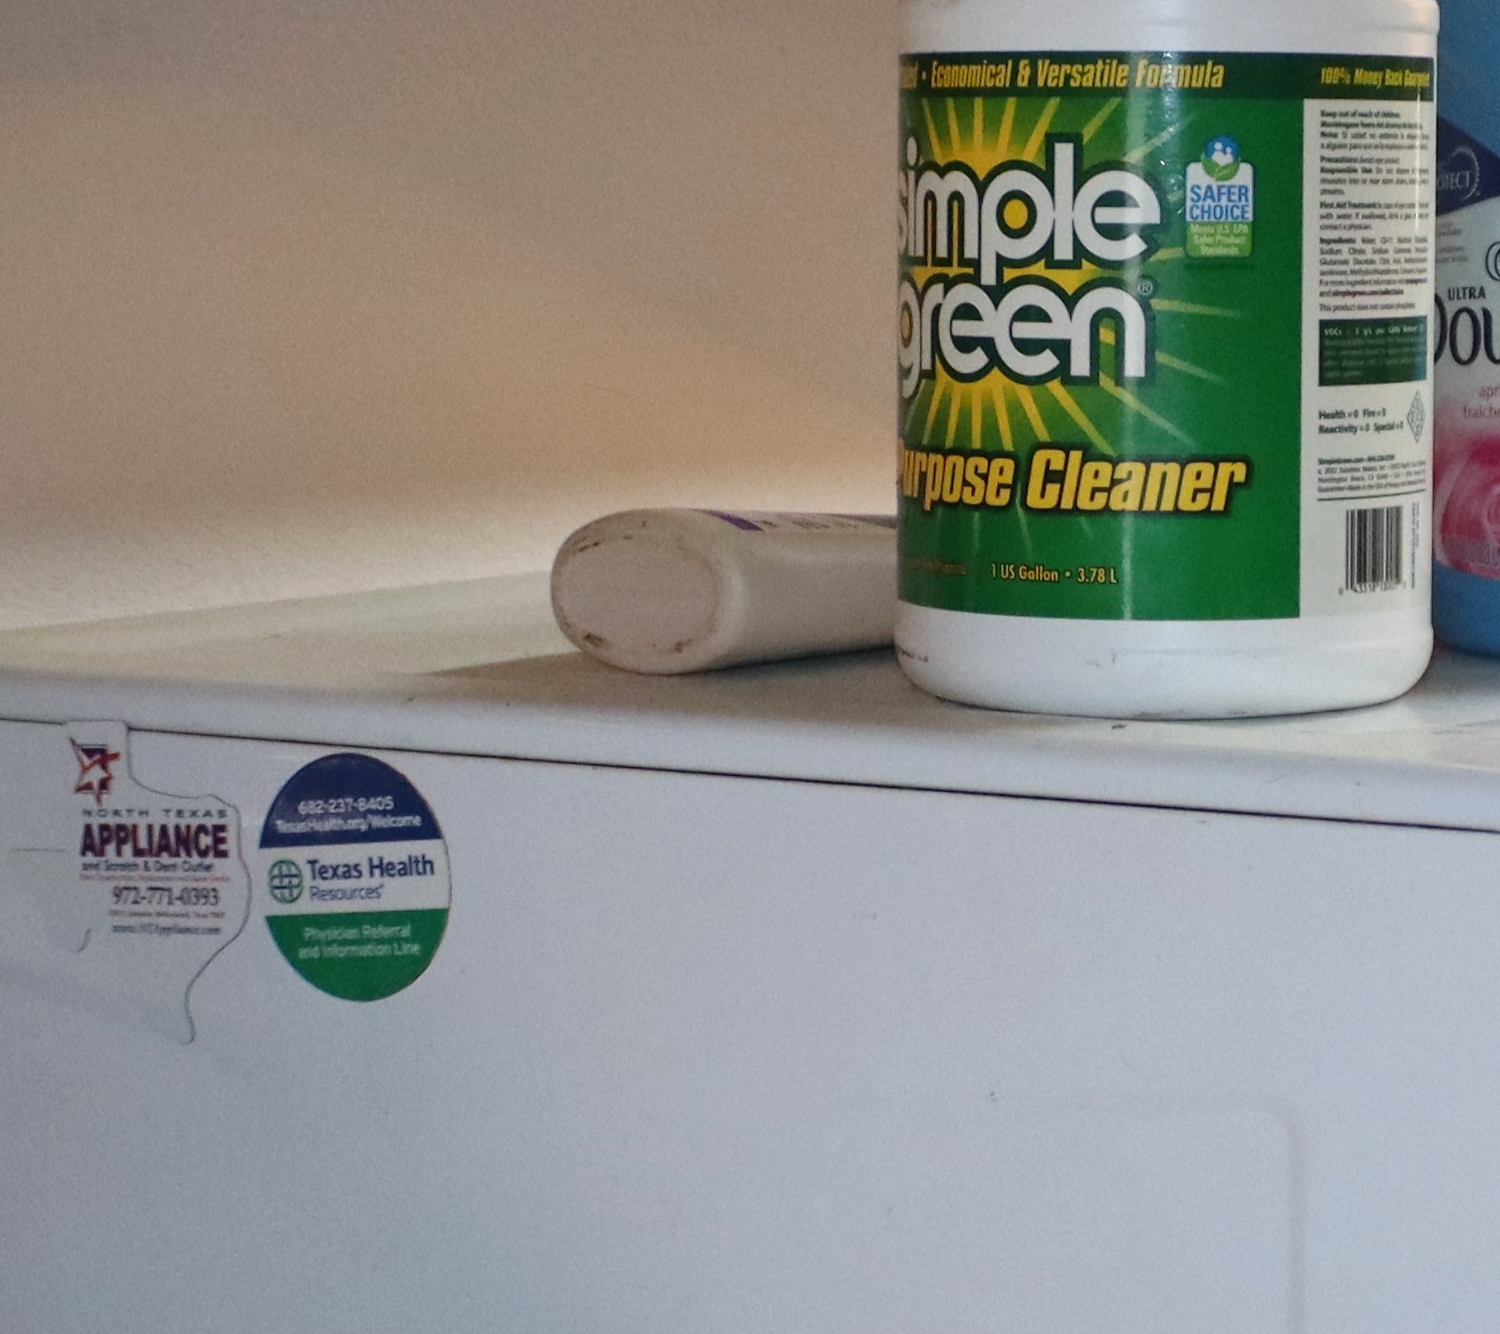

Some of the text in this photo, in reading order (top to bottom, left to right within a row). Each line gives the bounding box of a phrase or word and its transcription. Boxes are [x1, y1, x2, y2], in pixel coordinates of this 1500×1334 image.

[931, 59, 1012, 88] Economical
[1017, 58, 1031, 88] &
[1037, 58, 1129, 88] Versatile
[1135, 60, 1225, 89] Formula
[1320, 66, 1351, 85] 100%
[1353, 67, 1384, 89] Money
[1189, 183, 1250, 204] SAFER
[1188, 203, 1251, 221] CHOICE
[1447, 285, 1487, 301] ULTRA
[900, 279, 1147, 400] green
[1318, 409, 1346, 420] Health
[1318, 423, 1358, 435] Reactivity
[1025, 448, 1248, 512] Cleaner
[1000, 563, 1016, 579] US
[1018, 565, 1059, 583] Gallon
[1076, 567, 1107, 584] 3.78
[81, 808, 228, 818] NORTH TEXAS
[80, 822, 230, 858] APPLIANCE
[305, 853, 436, 881] Texas Health
[309, 885, 379, 901] Resources
